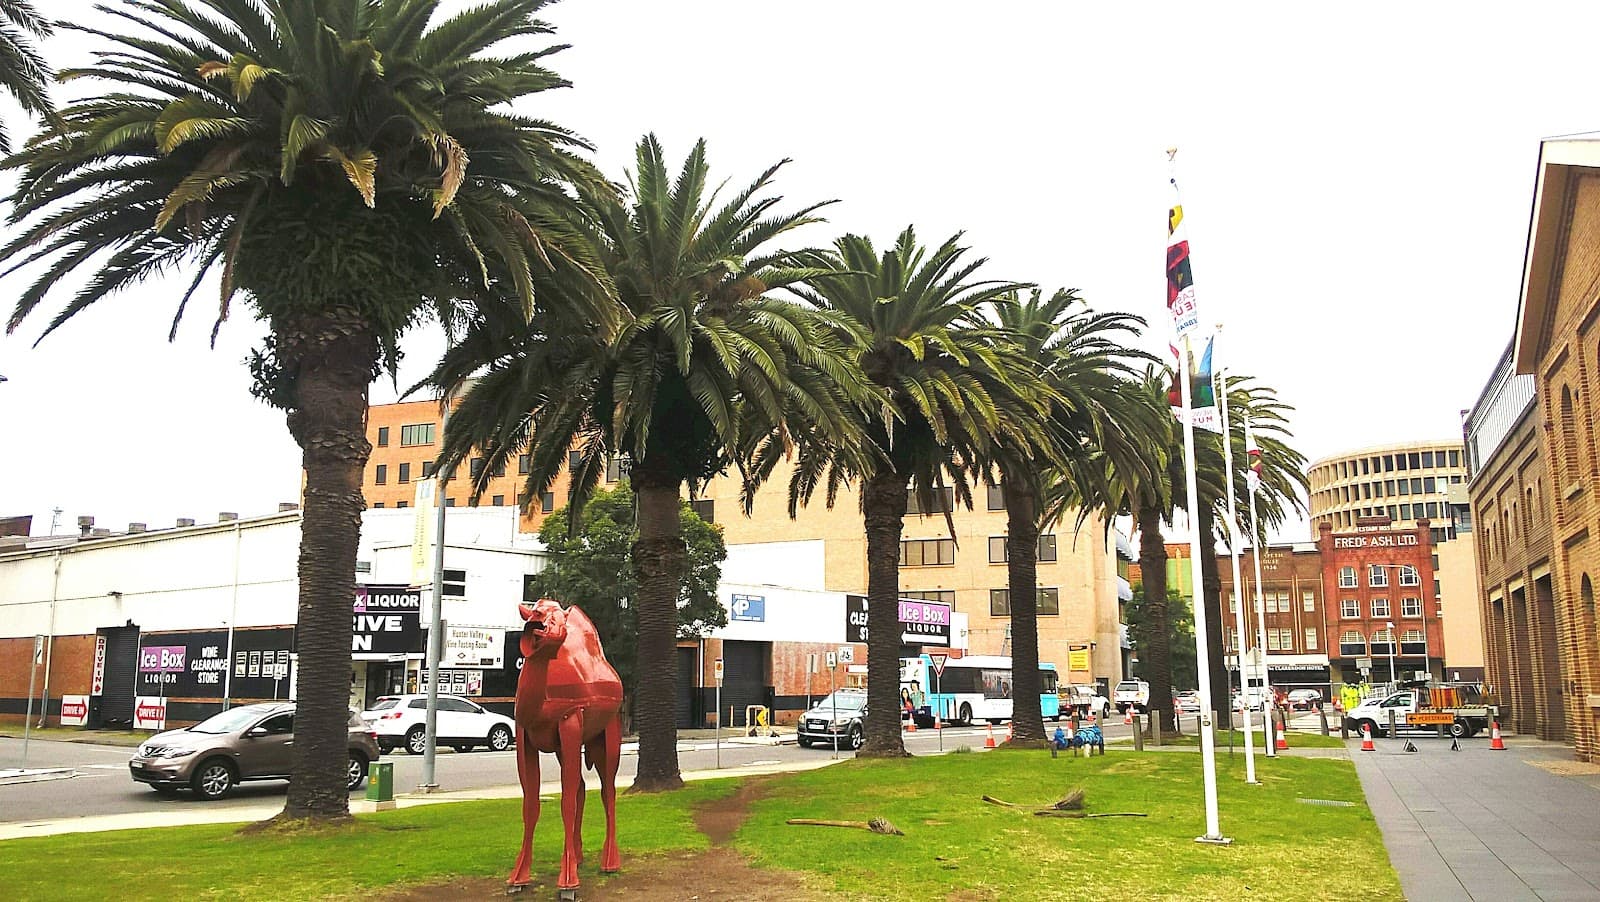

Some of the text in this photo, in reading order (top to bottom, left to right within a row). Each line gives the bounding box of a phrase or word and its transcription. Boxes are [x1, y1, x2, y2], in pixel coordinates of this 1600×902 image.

[367, 594, 419, 608] LIQUOR
[902, 603, 944, 623] Ice Box
[352, 615, 403, 632] IVE
[906, 623, 942, 633] LIQUOR
[140, 649, 184, 668] Ice Box
[198, 671, 219, 684] STORE
[63, 705, 78, 715] DRIVE
[138, 708, 156, 718] DRIVE
